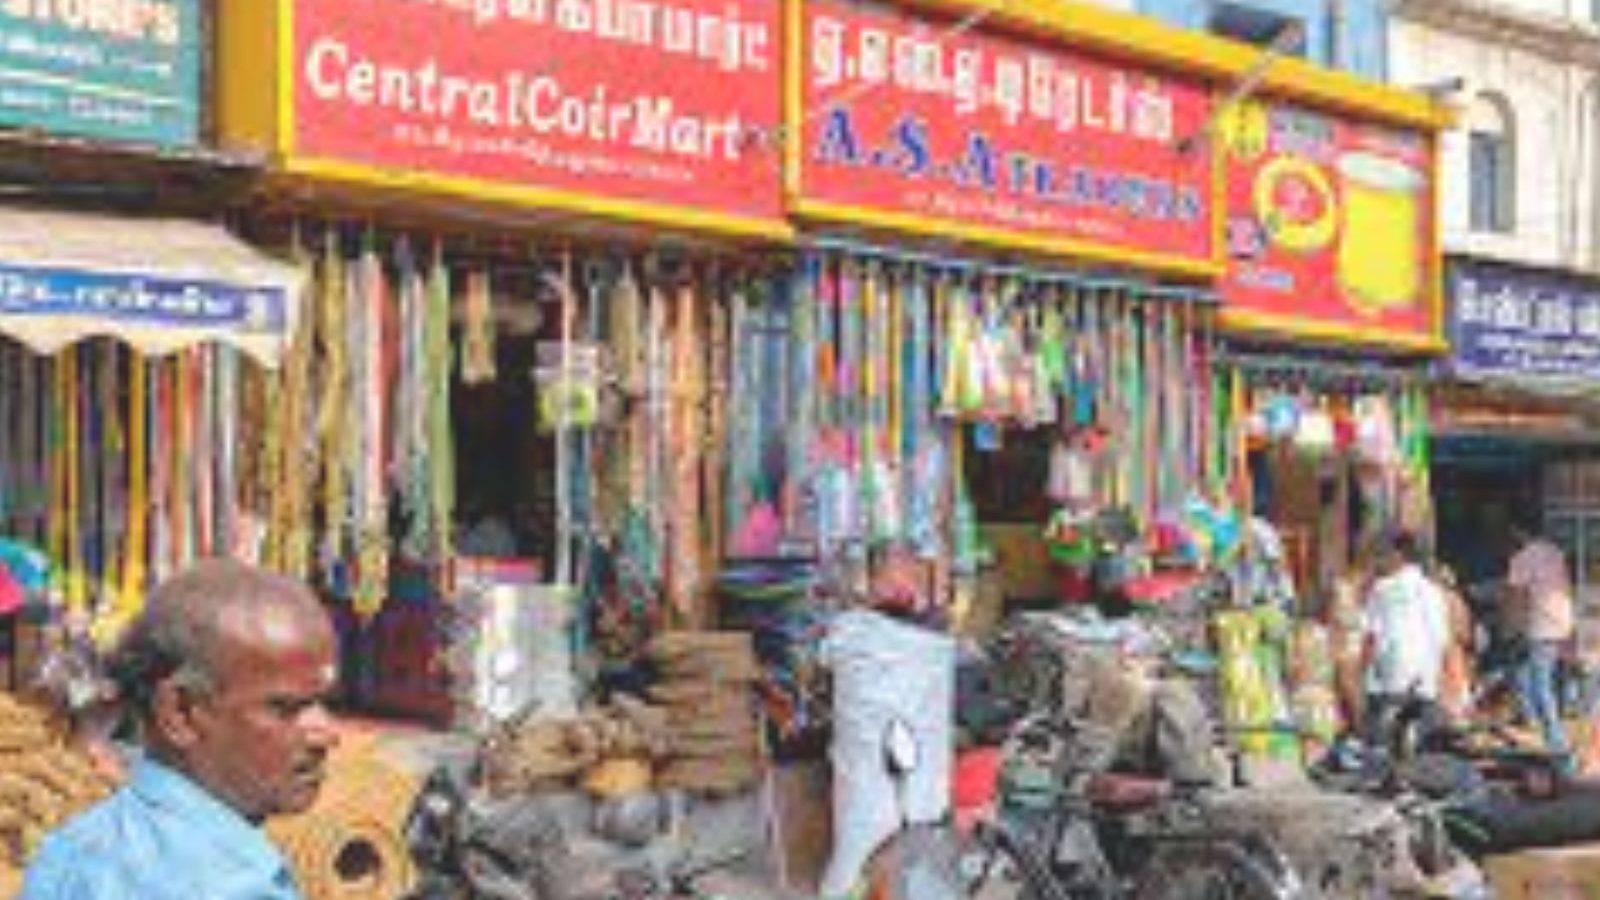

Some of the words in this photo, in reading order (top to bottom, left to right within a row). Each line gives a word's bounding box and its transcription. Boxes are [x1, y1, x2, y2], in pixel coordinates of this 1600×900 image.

[304, 36, 522, 127] Central
[525, 72, 634, 142] Coir
[630, 92, 742, 162] Mart
